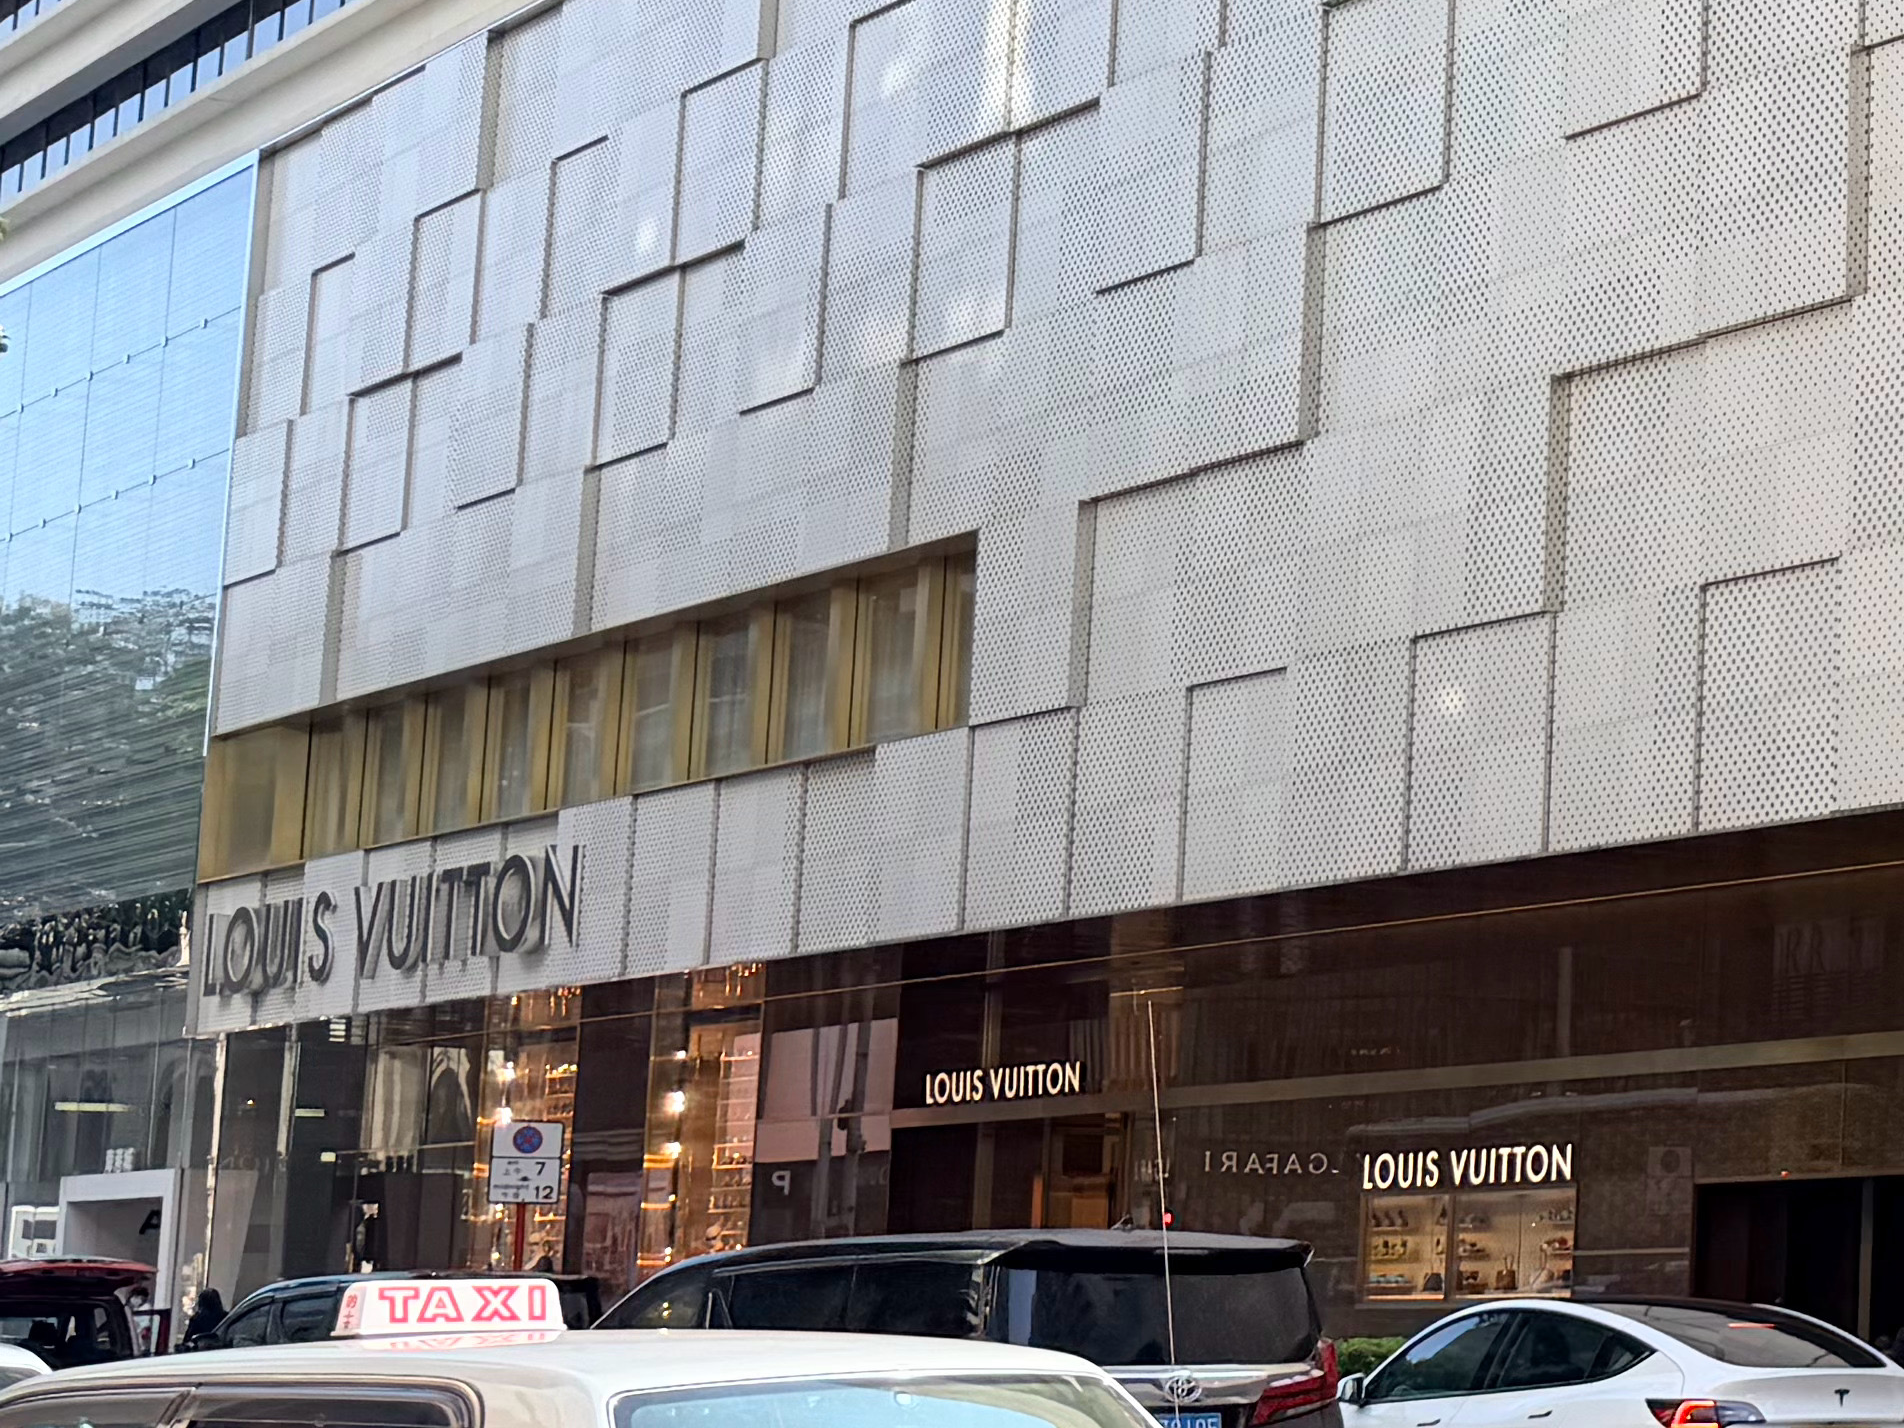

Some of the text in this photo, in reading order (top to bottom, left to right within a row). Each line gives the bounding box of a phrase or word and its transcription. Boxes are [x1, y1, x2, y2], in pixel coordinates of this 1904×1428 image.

[203, 844, 581, 996] LOUIS VUITTON
[926, 1061, 1081, 1104] LOUIS VUITTON
[535, 1161, 546, 1176] 7
[1363, 1143, 1573, 1190] LOUIS VUITTON
[535, 1185, 554, 1200] 12
[378, 1285, 547, 1323] TAXI
